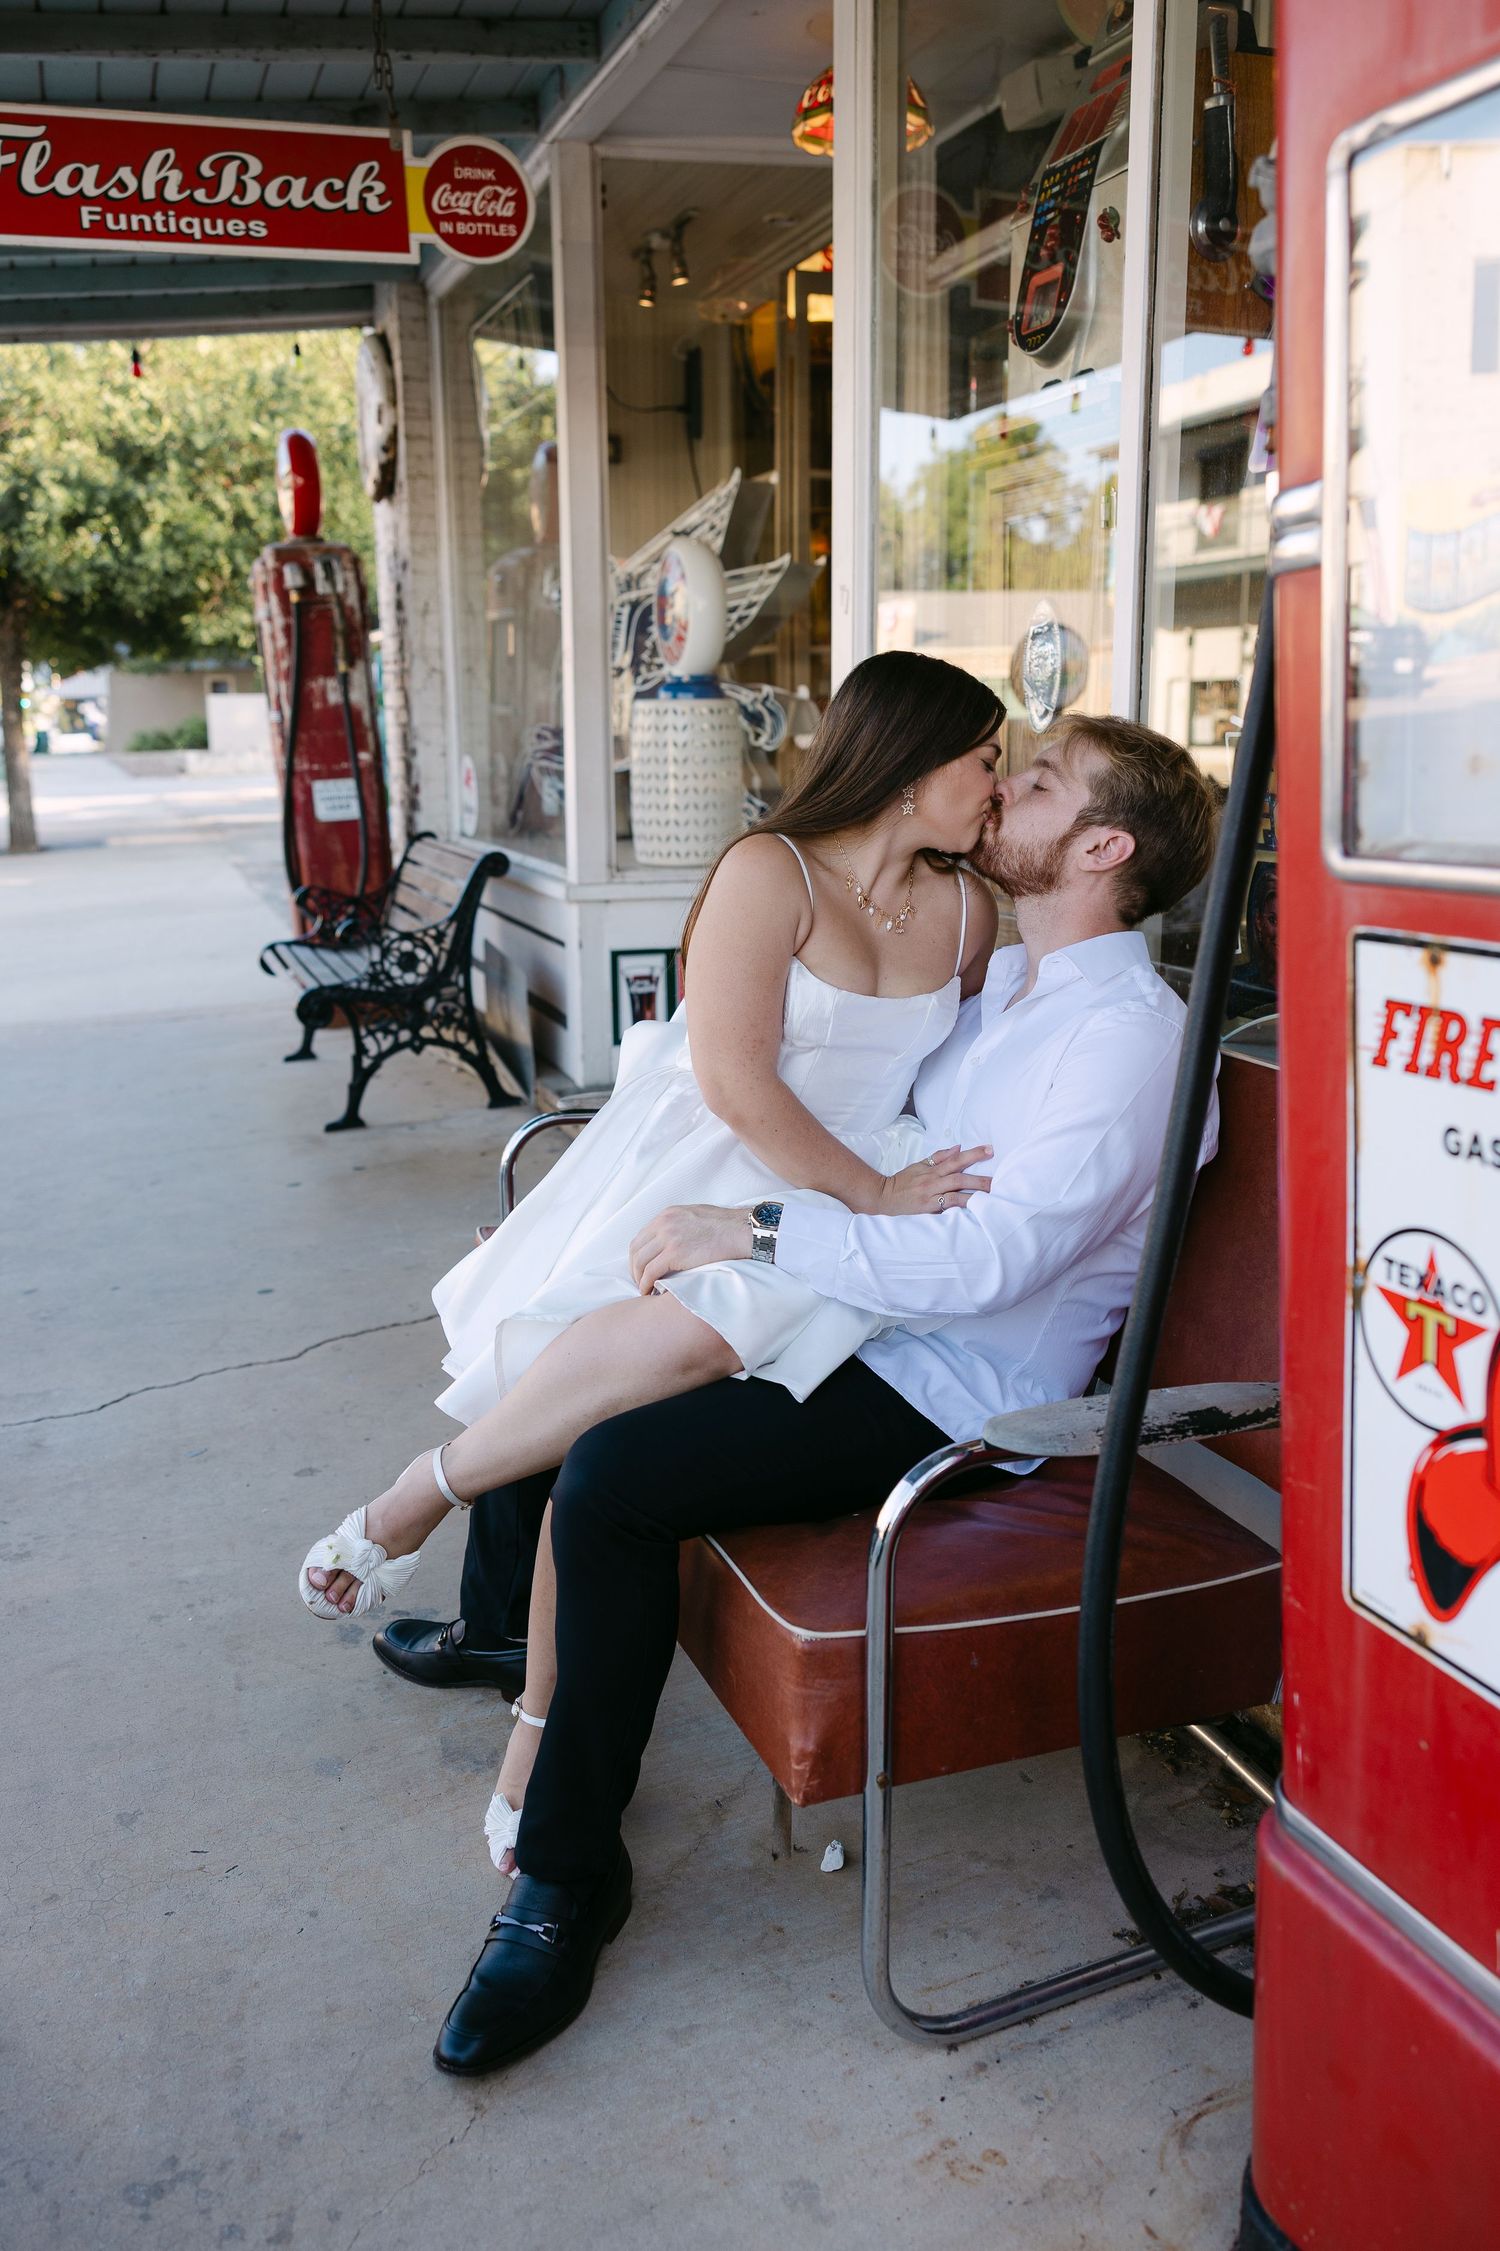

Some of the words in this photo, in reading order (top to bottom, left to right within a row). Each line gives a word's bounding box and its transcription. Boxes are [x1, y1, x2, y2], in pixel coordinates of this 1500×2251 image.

[192, 150, 393, 214] Back
[453, 166, 496, 181] DRINK
[80, 205, 269, 240] Funtiques
[439, 221, 454, 234] IN
[456, 222, 518, 237] BOTTLES
[1371, 998, 1500, 1092] FIRE
[1384, 1256, 1488, 1316] TEXACO
